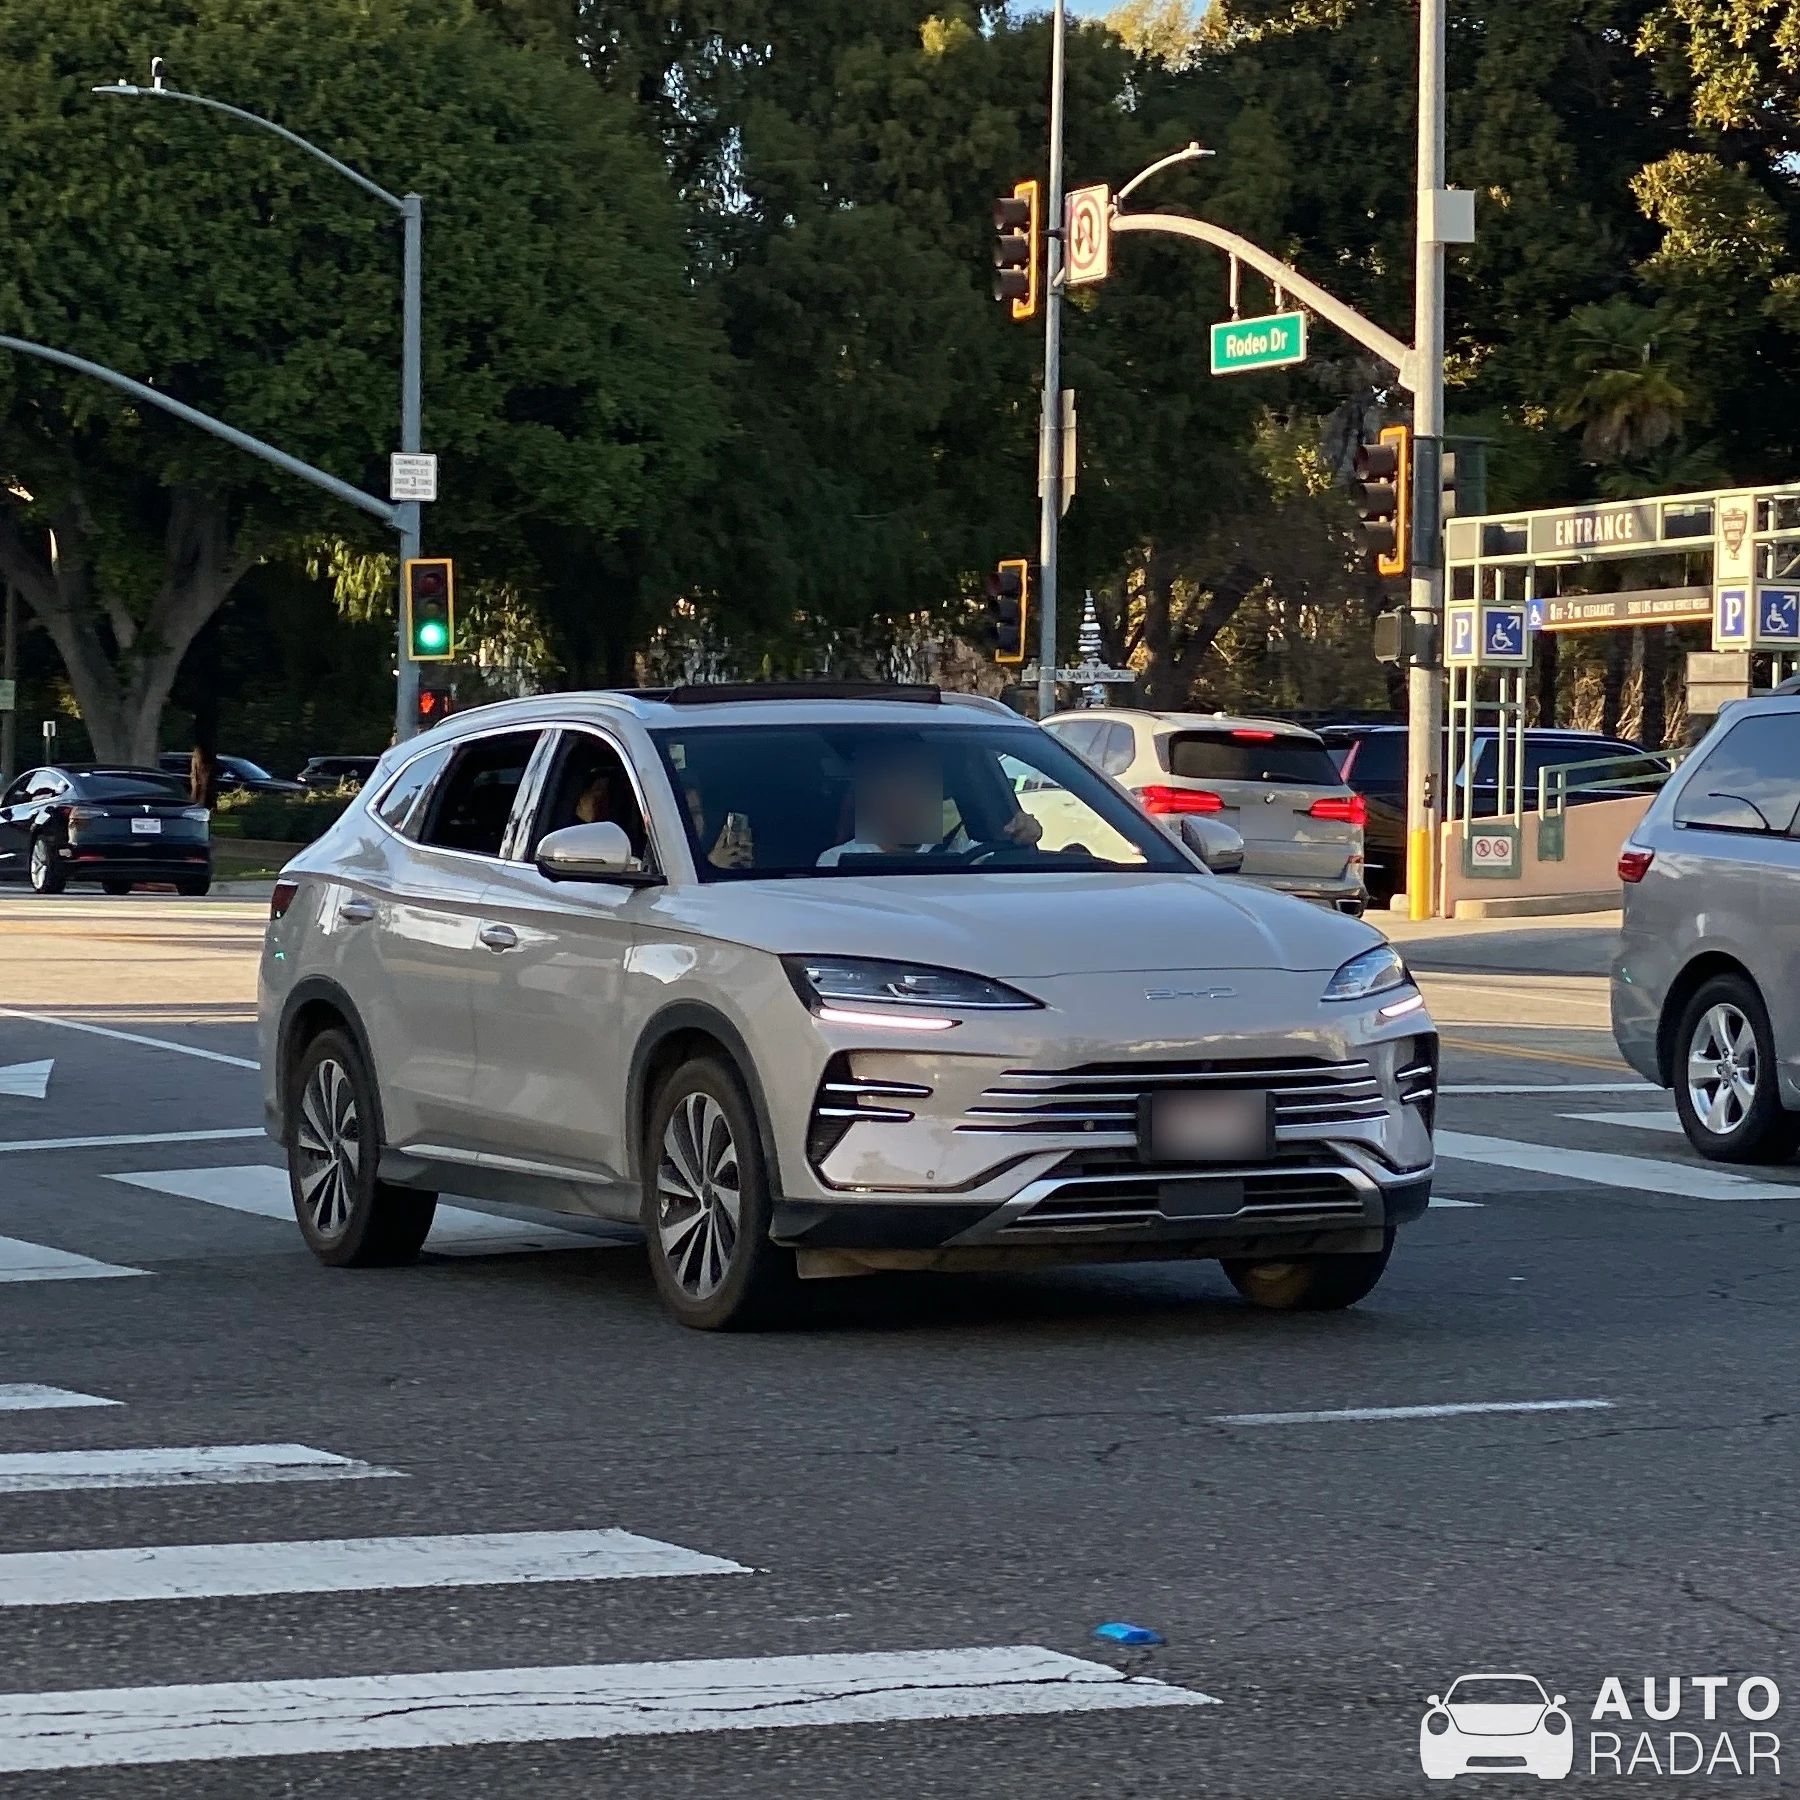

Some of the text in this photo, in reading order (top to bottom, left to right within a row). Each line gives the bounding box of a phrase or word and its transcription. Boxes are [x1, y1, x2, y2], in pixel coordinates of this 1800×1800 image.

[1226, 327, 1288, 358] Rodeo Dr
[410, 476, 417, 487] 3
[1555, 512, 1633, 546] ENTRANCE
[1725, 598, 1741, 631] P
[1455, 618, 1469, 648] P
[1144, 987, 1238, 1000] BYD
